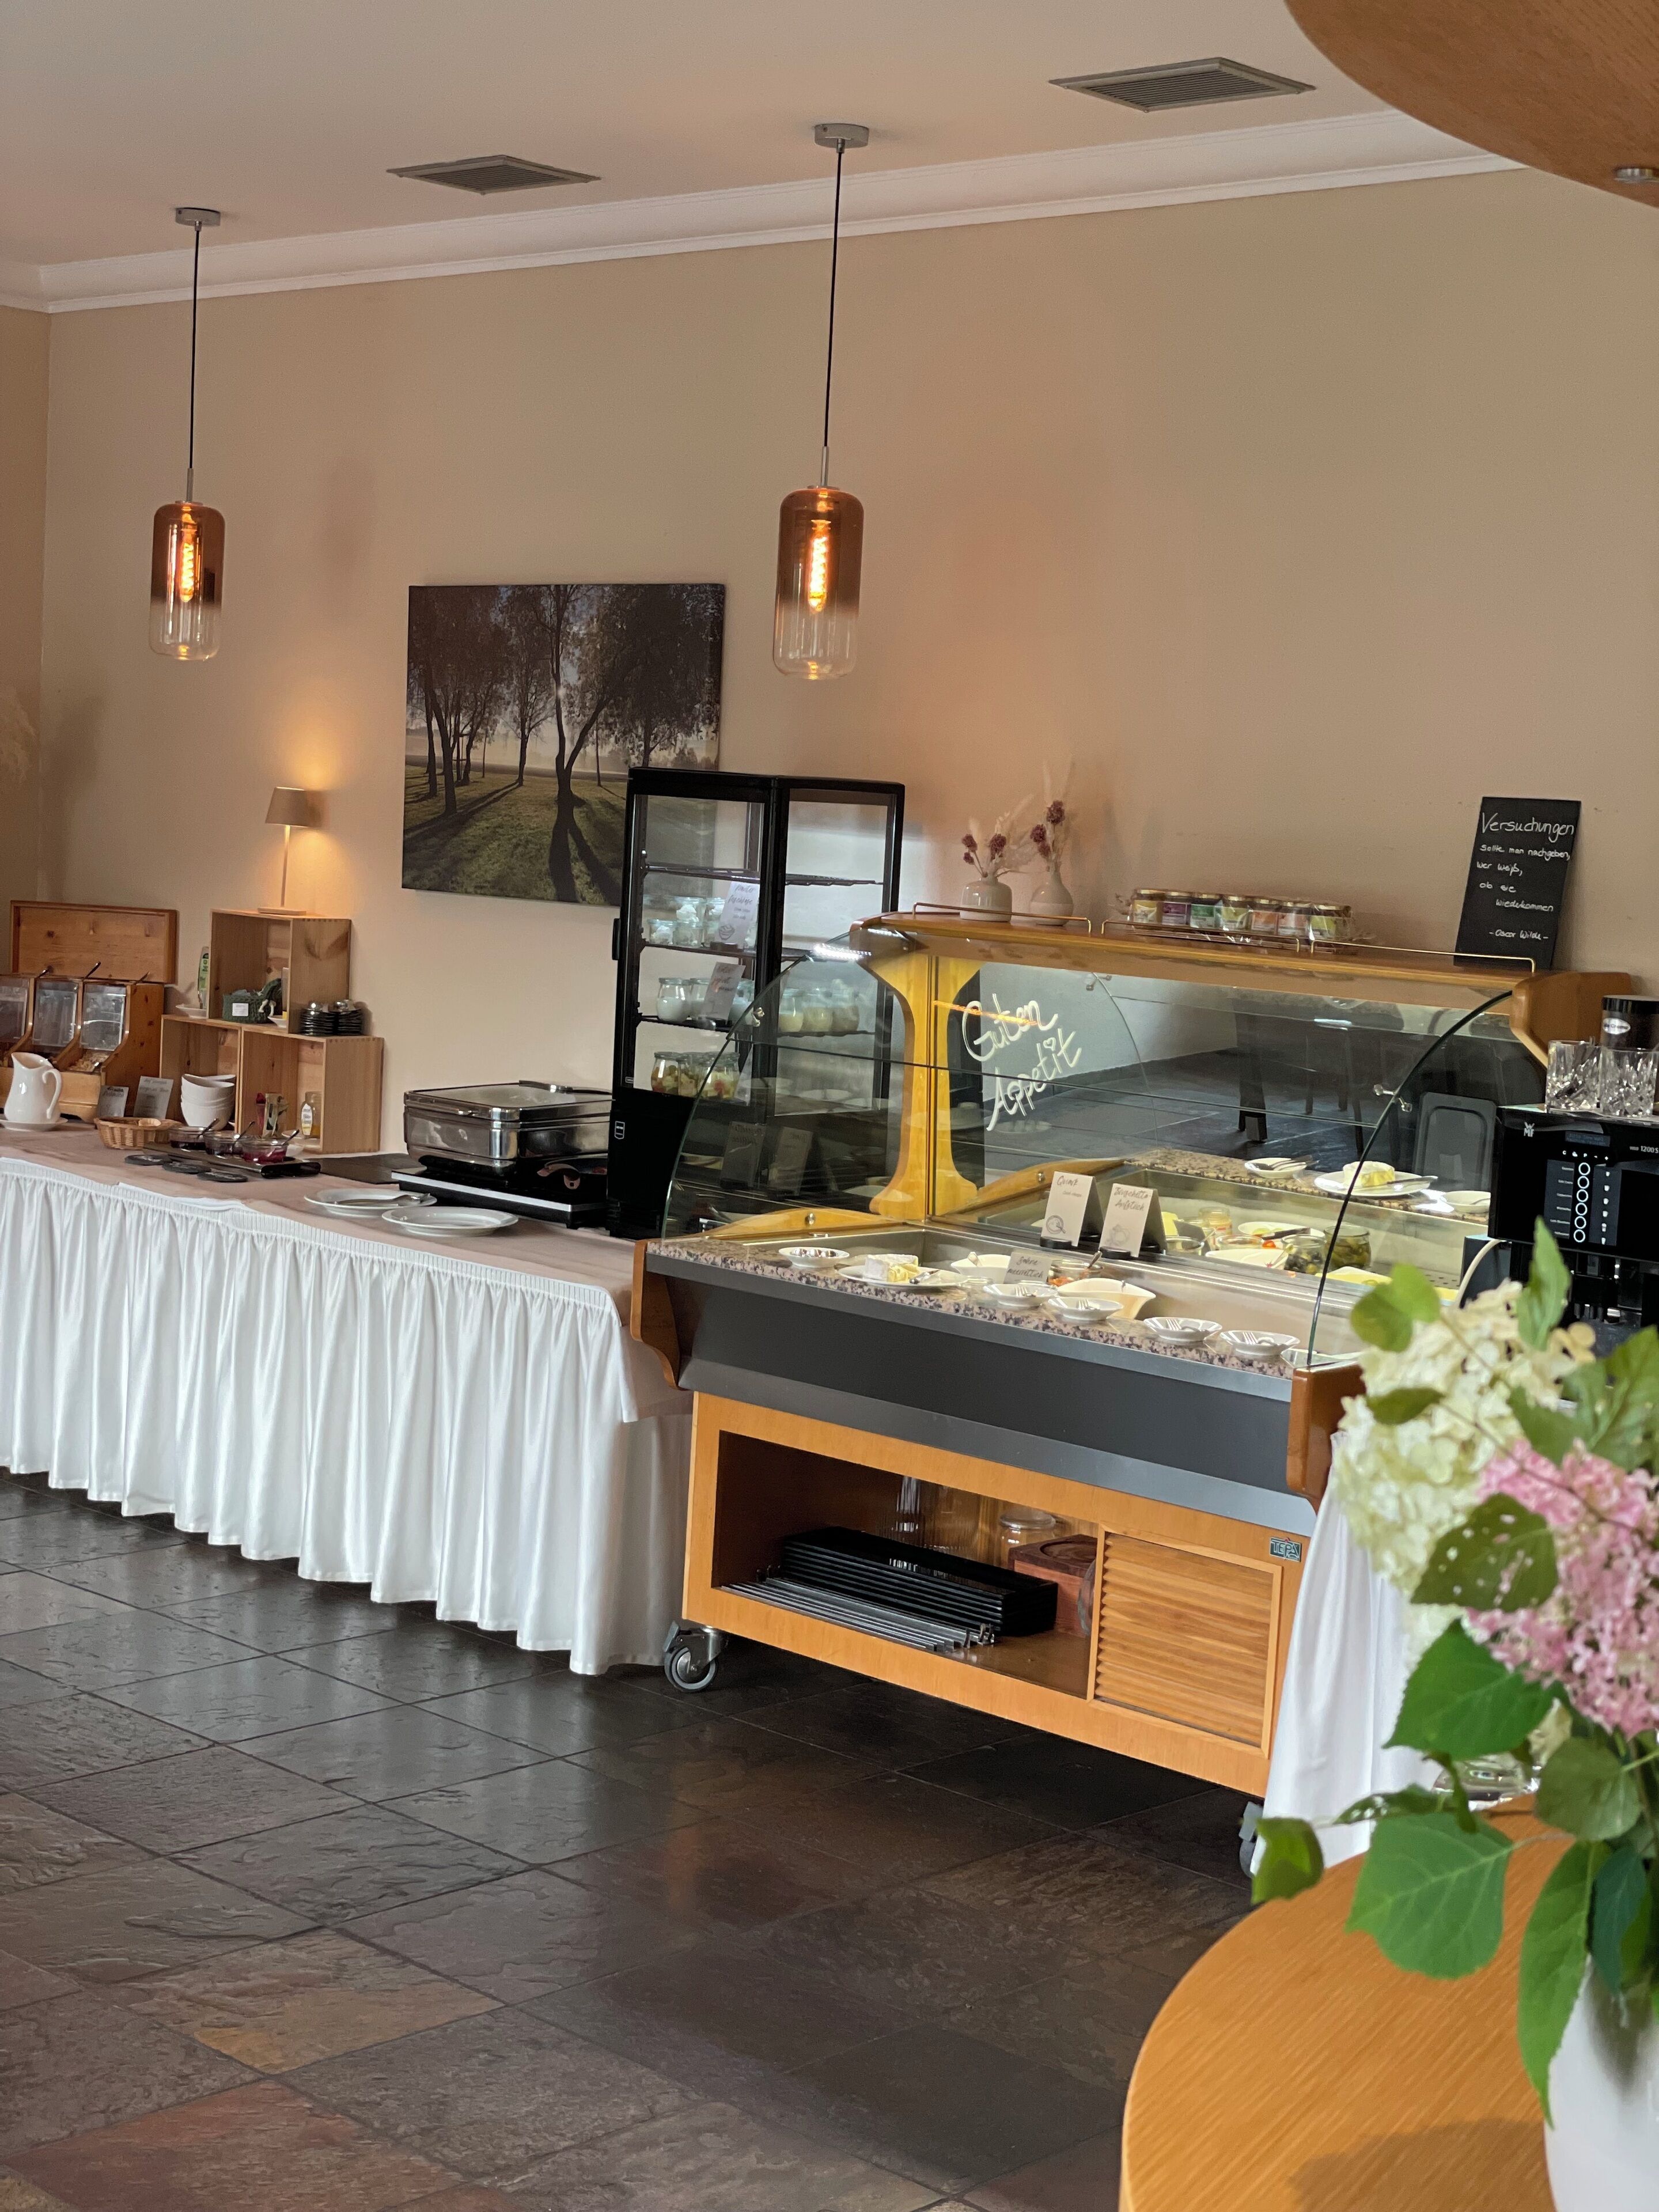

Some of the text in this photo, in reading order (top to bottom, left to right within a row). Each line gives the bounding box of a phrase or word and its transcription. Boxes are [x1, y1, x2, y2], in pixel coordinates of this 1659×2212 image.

[1482, 812, 1574, 843] Versuchungen
[1528, 849, 1571, 861] nachgeben,
[1479, 881, 1493, 889] ob
[961, 993, 1059, 1062] Guten
[986, 1028, 1082, 1131] Appetit
